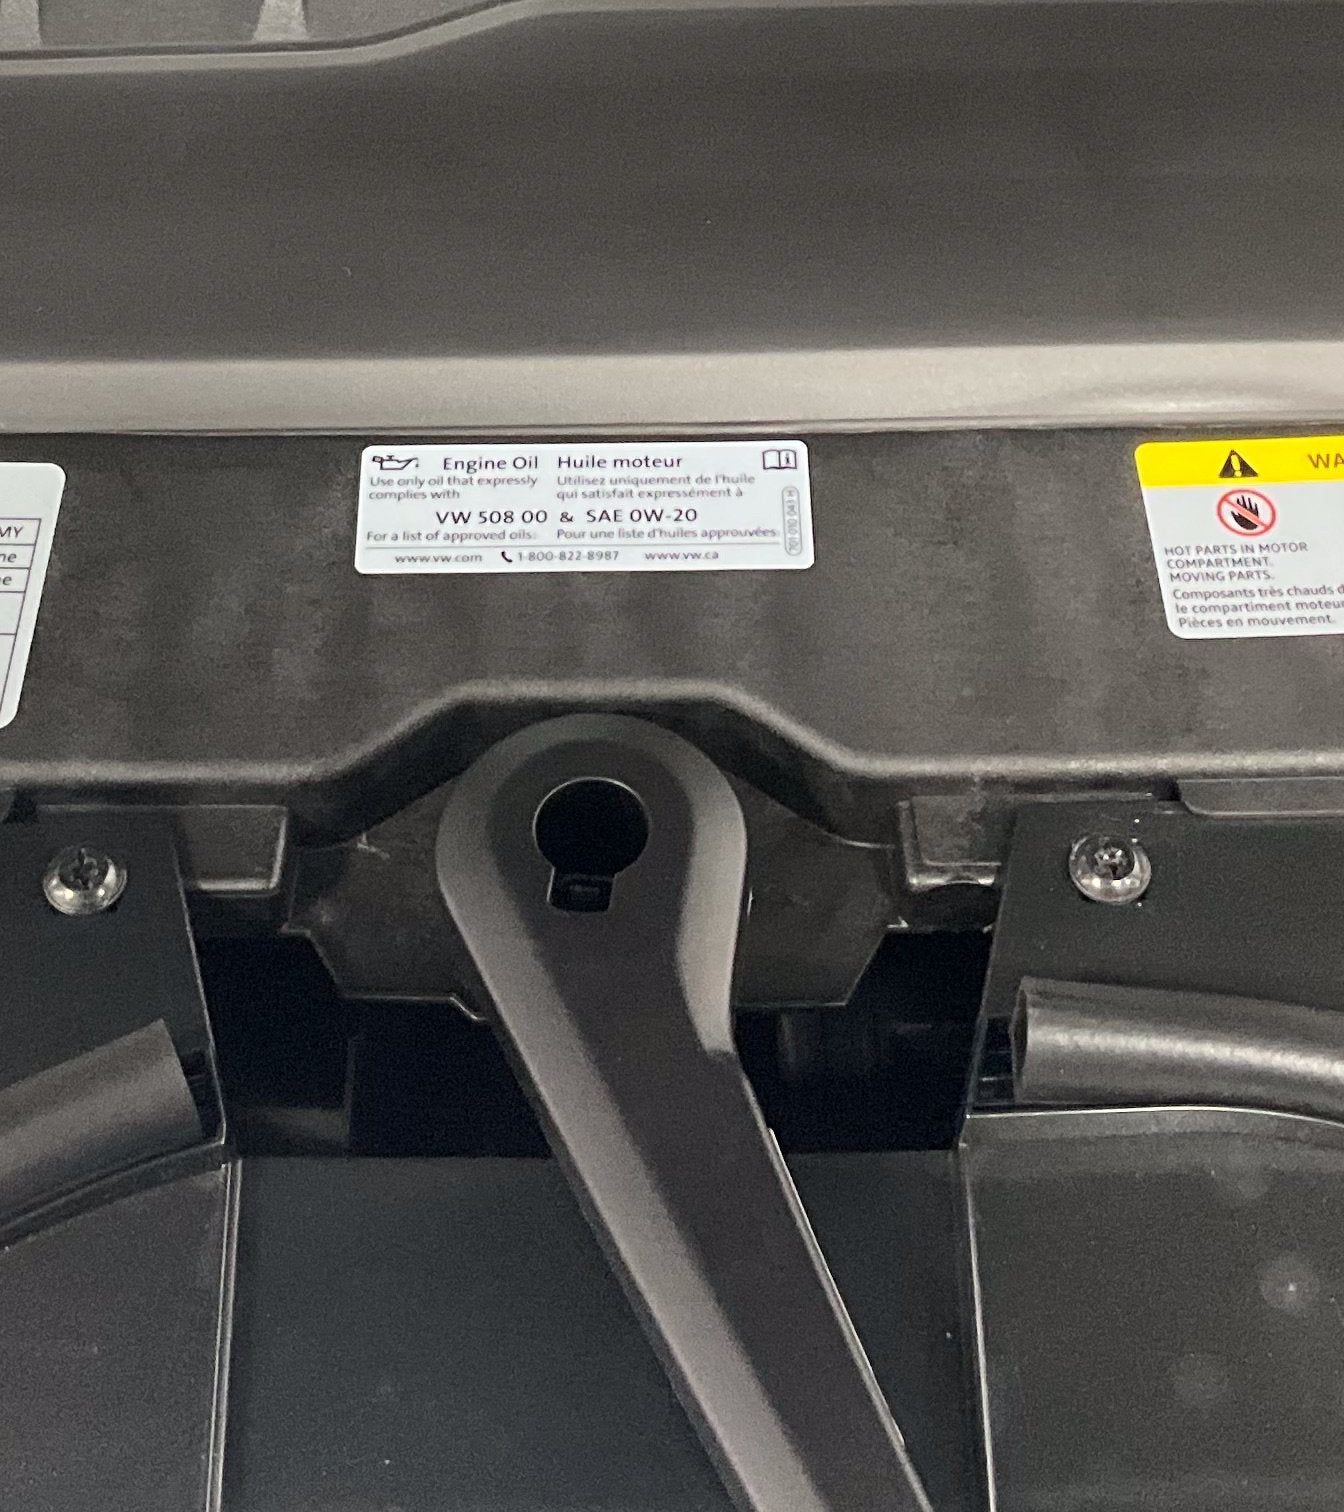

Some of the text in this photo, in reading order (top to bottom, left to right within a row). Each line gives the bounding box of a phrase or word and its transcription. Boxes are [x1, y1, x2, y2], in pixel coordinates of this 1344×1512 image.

[443, 455, 539, 475] Engine Oil
[558, 455, 683, 469] Huile moteur
[370, 475, 539, 490] Use only oil that expressly
[557, 475, 606, 487] Utilisez
[609, 475, 692, 488] uniquement
[695, 473, 712, 486] de
[368, 489, 428, 503] complies
[556, 489, 579, 503] qui
[581, 488, 635, 500] satisfait
[636, 486, 732, 502] expressément
[435, 508, 698, 525] VW 508 00 & SAE 0W-20
[366, 529, 507, 544] For a list of approved
[556, 528, 587, 540] Pour
[589, 530, 616, 540] une
[618, 527, 645, 539] liste
[1164, 541, 1309, 557] HOT PARTS IN MOTOR
[1169, 571, 1226, 583] MOVING
[1172, 588, 1257, 601] Composants
[1257, 586, 1285, 598] très
[1286, 584, 1335, 597] chauds
[1175, 602, 1190, 614] le
[1191, 601, 1293, 615] compartiment
[1178, 617, 1224, 629] Pièces
[1226, 618, 1245, 628] en
